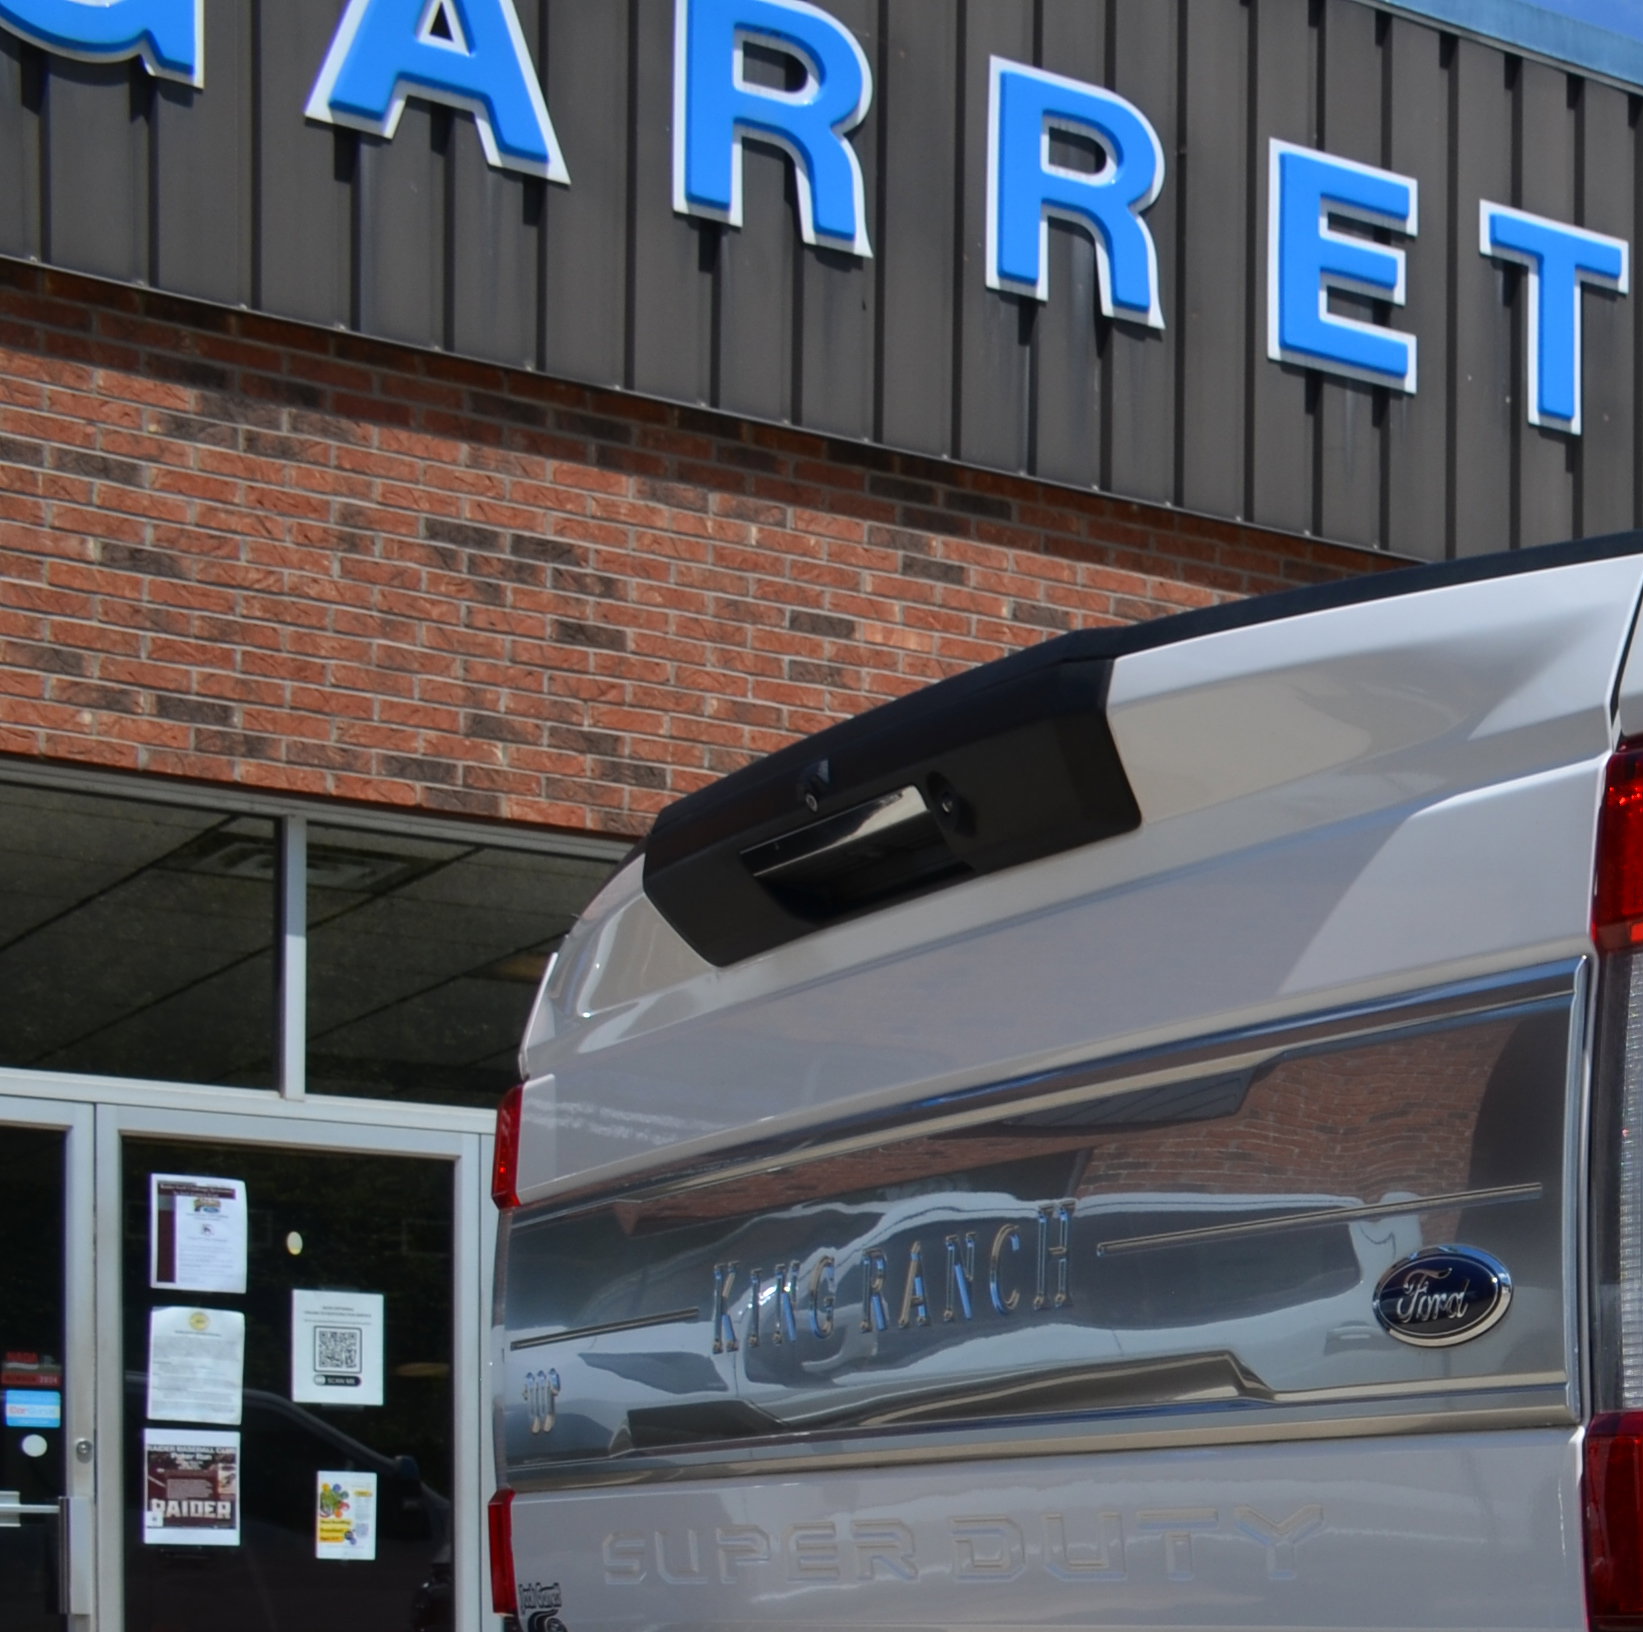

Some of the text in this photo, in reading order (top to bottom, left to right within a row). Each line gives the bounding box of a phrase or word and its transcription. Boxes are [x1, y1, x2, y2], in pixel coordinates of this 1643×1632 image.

[712, 1200, 1076, 1354] KING RANCH
[1394, 1266, 1469, 1324] Ford
[150, 1498, 232, 1520] RAIDER
[602, 1502, 1325, 1587] SUPER DUTY
